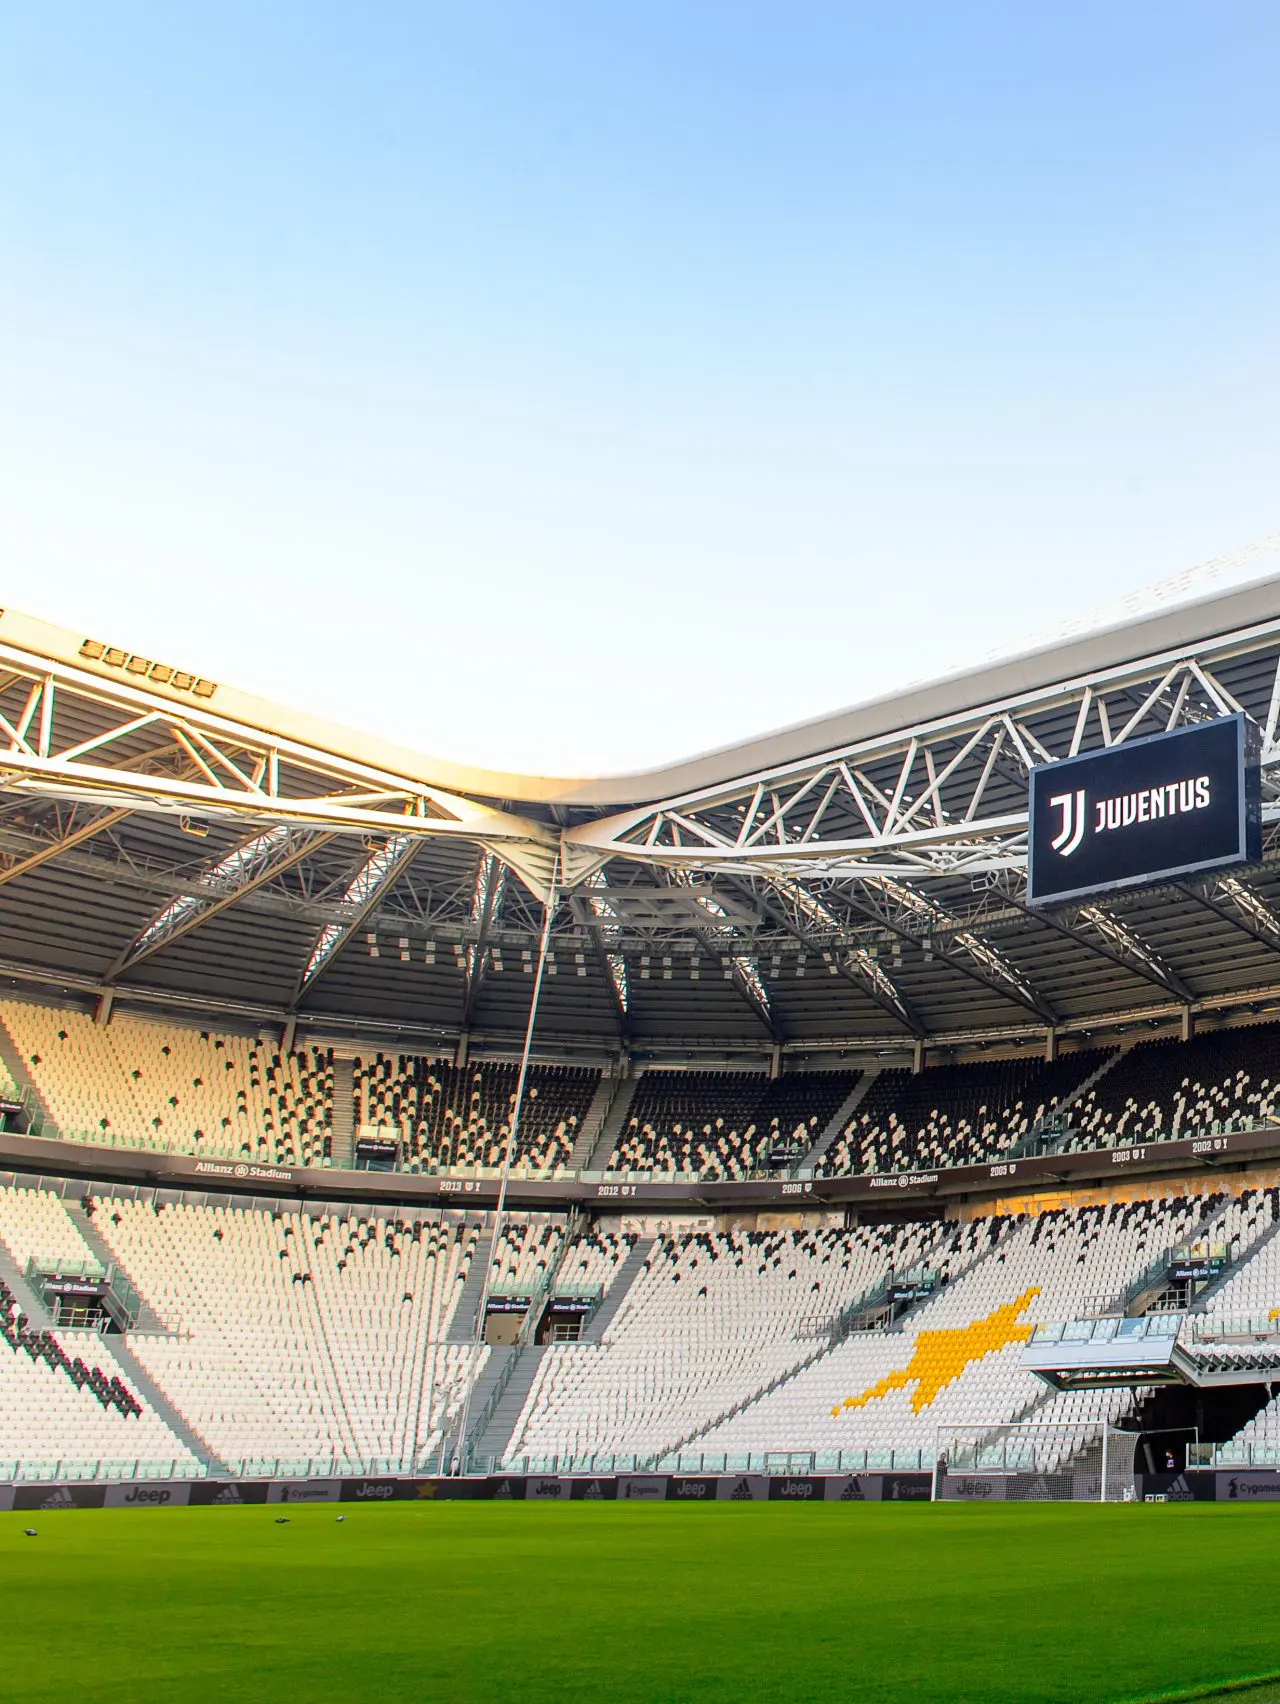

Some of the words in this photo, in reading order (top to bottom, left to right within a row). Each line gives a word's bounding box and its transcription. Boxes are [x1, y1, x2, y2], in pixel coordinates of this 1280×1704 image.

[1095, 776, 1210, 833] JUVENTUS
[1192, 1141, 1212, 1152] 2002
[1112, 1151, 1131, 1163] 2003
[195, 1162, 233, 1175] Allianz
[250, 1167, 292, 1180] Stadium
[990, 1165, 1008, 1177] 2005
[440, 1181, 462, 1192] 2013
[870, 1178, 898, 1188] Allianz
[909, 1174, 938, 1186] Stadium
[598, 1186, 619, 1196] 2012
[125, 1487, 171, 1504] Jeep
[357, 1483, 394, 1498] Jeep
[536, 1482, 562, 1497] Jeep
[678, 1480, 707, 1498] Jeep
[781, 1479, 813, 1498] Jeep
